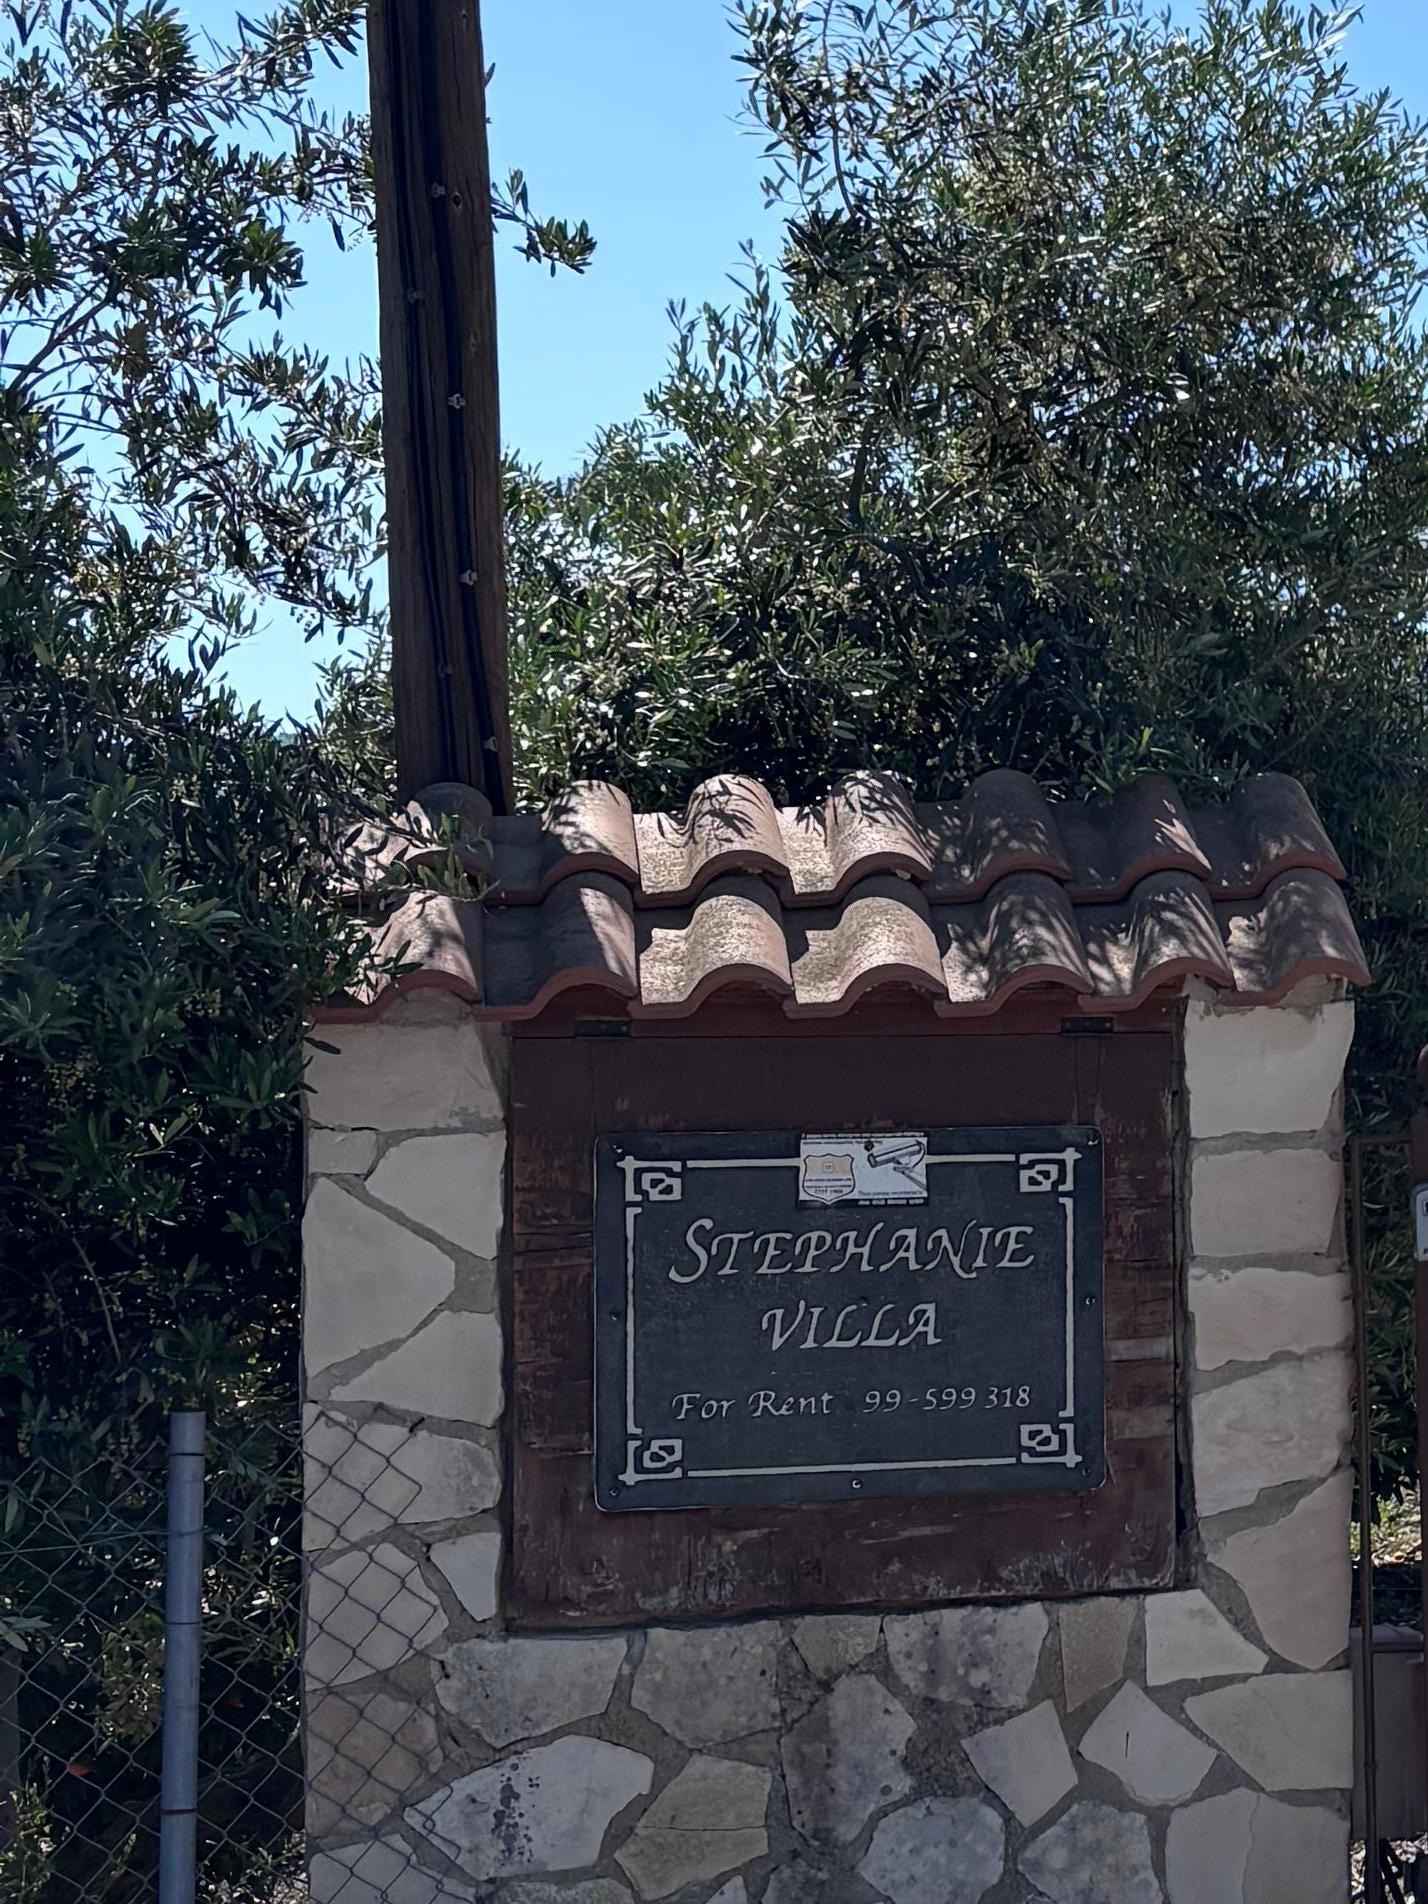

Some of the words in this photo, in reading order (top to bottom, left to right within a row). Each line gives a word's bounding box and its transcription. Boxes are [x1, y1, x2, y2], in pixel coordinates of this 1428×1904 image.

[668, 1217, 1036, 1284] STEPHANIE
[761, 1299, 943, 1352] VILLA
[671, 1393, 736, 1421] For
[747, 1390, 834, 1417] Rent
